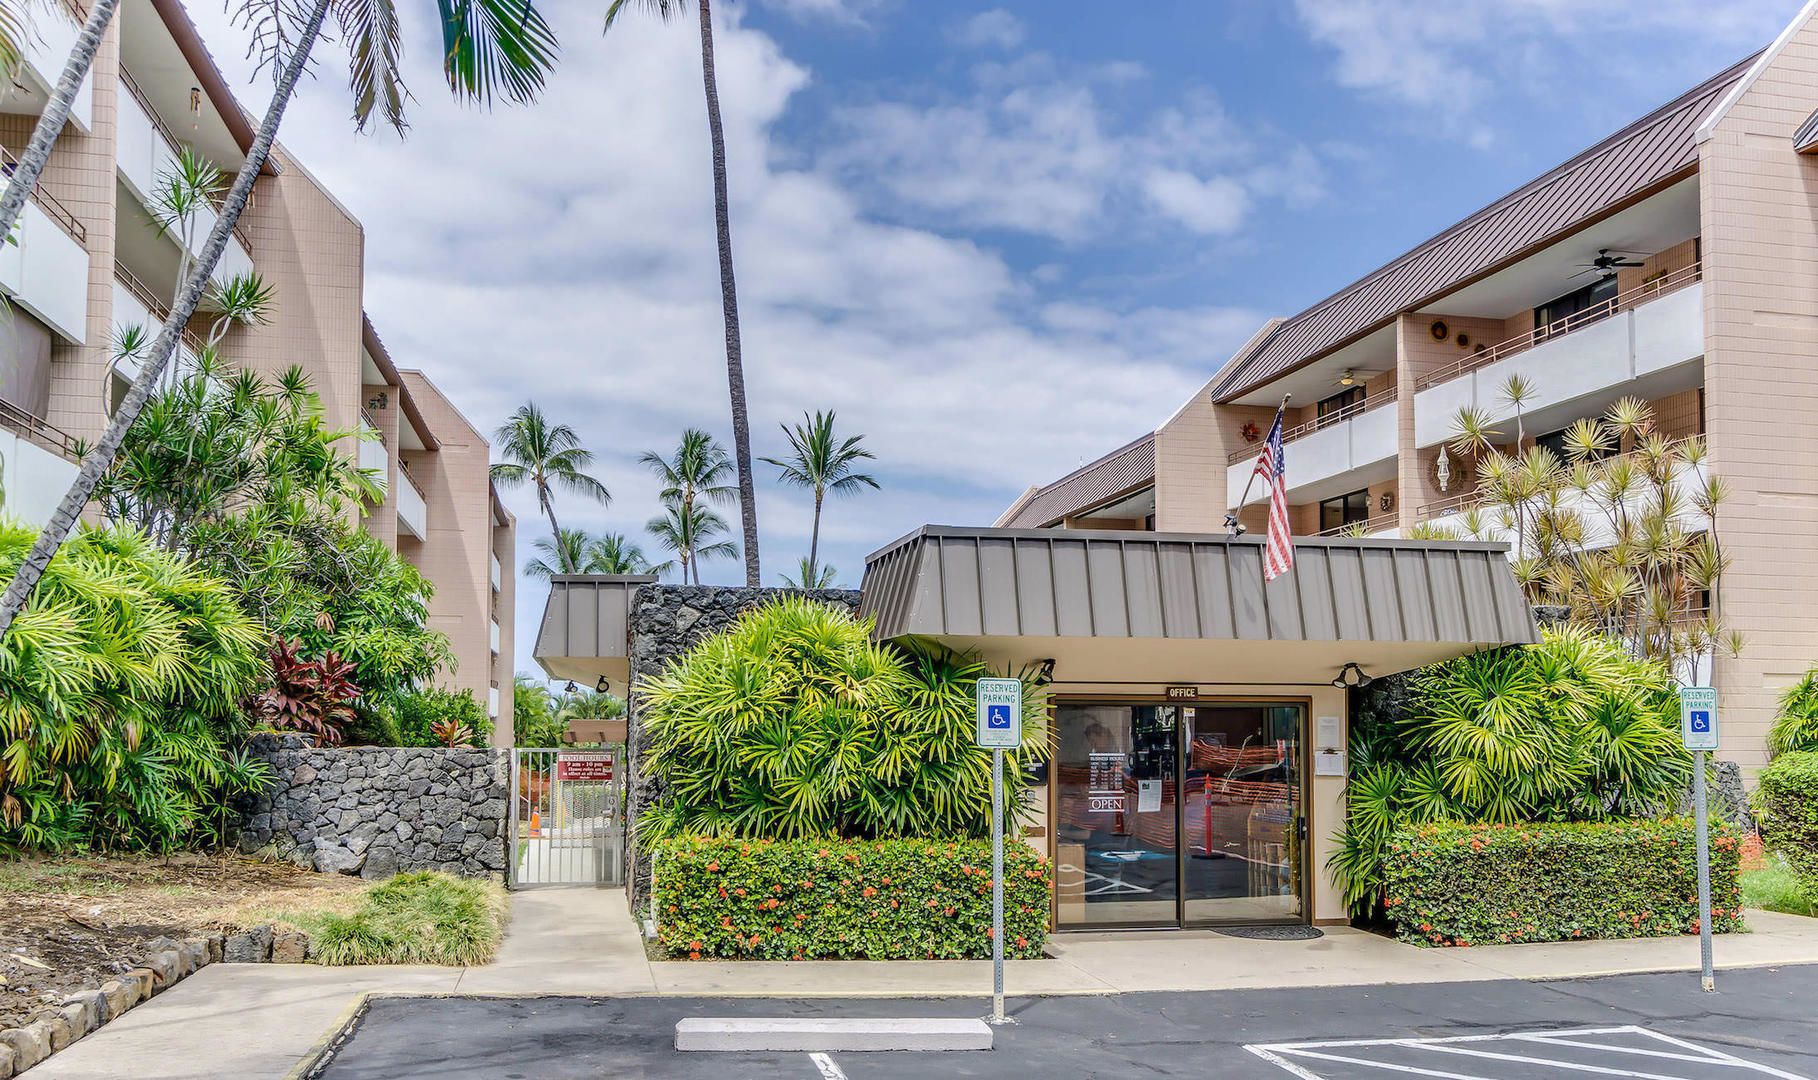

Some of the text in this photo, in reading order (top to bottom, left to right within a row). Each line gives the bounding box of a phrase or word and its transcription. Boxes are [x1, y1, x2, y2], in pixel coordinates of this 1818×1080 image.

[980, 683, 1018, 693] RESERVED
[1170, 688, 1196, 697] OFFICE
[983, 694, 1016, 703] PARKING
[1683, 691, 1715, 700] RESERVED
[1686, 701, 1713, 709] PARKING
[1091, 799, 1122, 809] OPEN
